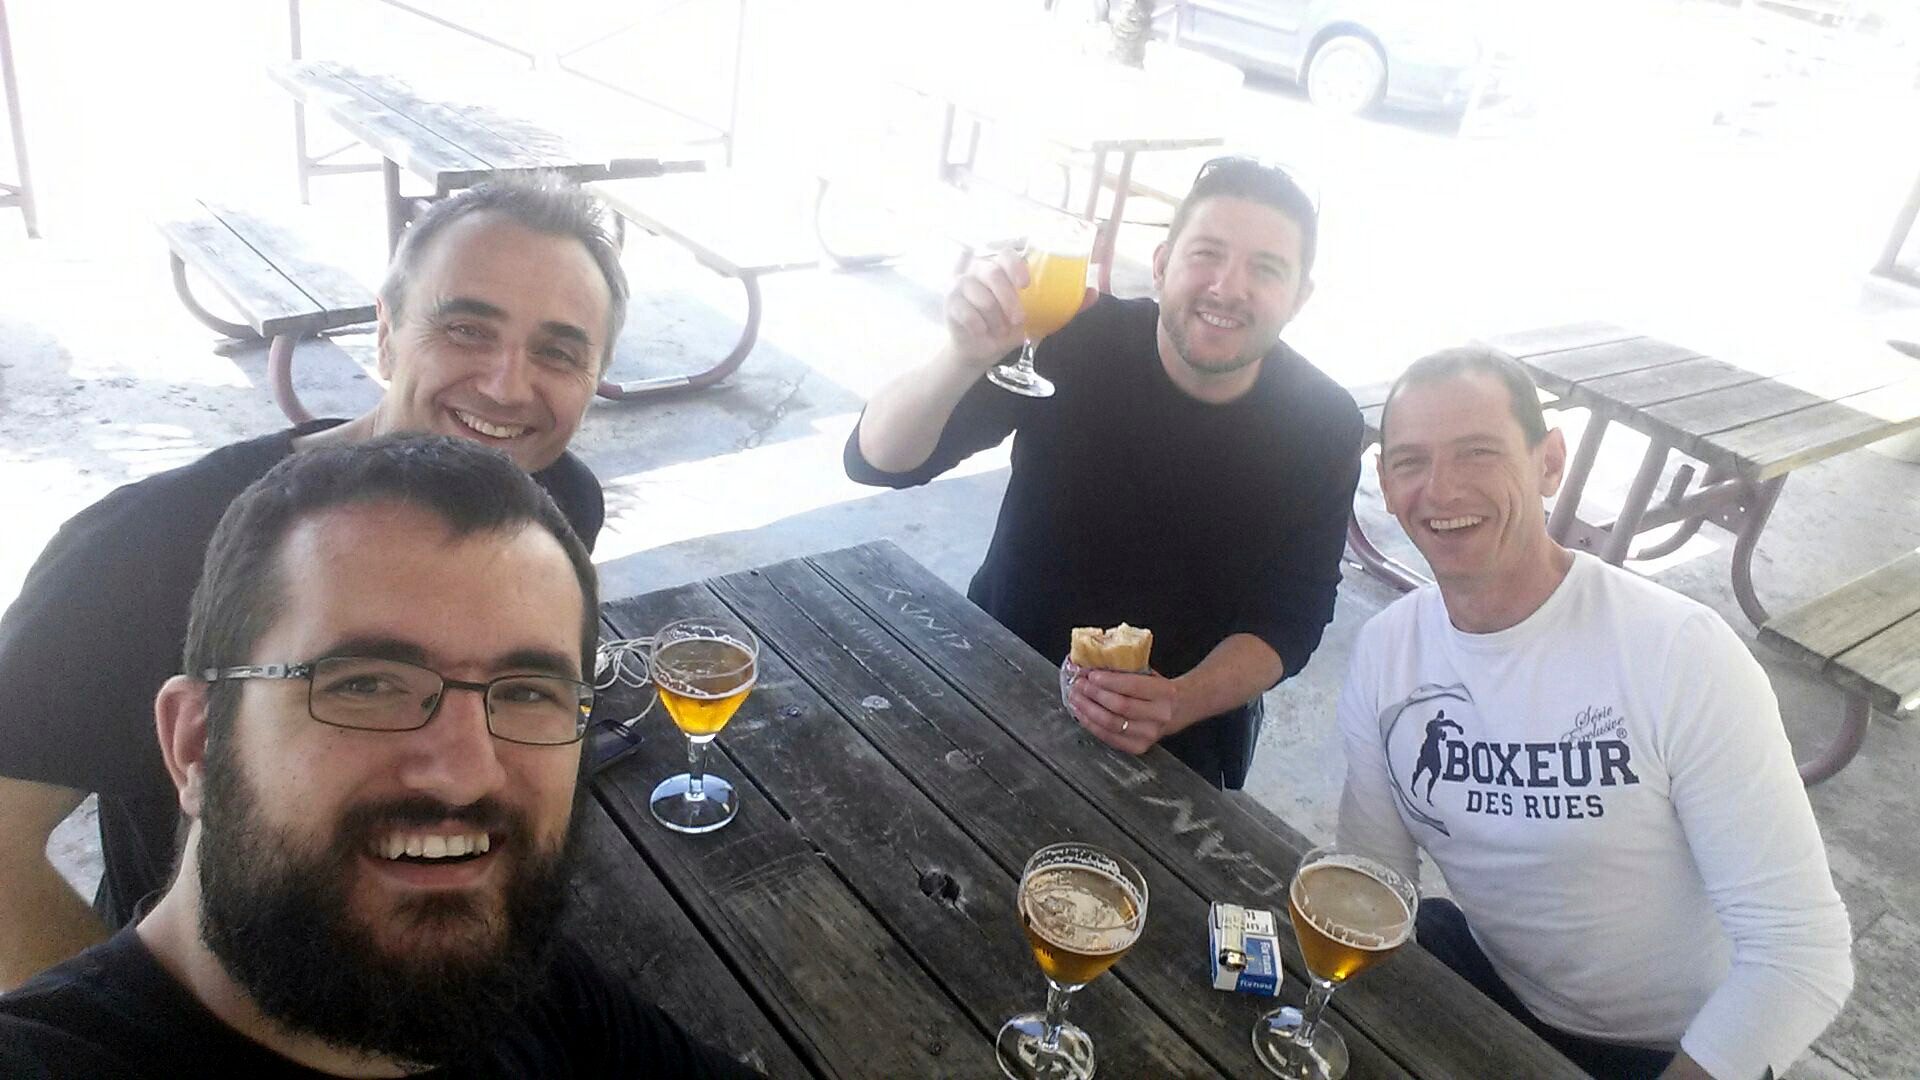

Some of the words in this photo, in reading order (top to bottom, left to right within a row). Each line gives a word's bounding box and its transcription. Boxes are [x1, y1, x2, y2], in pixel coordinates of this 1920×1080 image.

[1442, 740, 1640, 788] BOXEUR
[1466, 790, 1513, 817] DES
[1523, 794, 1605, 819] RUES
